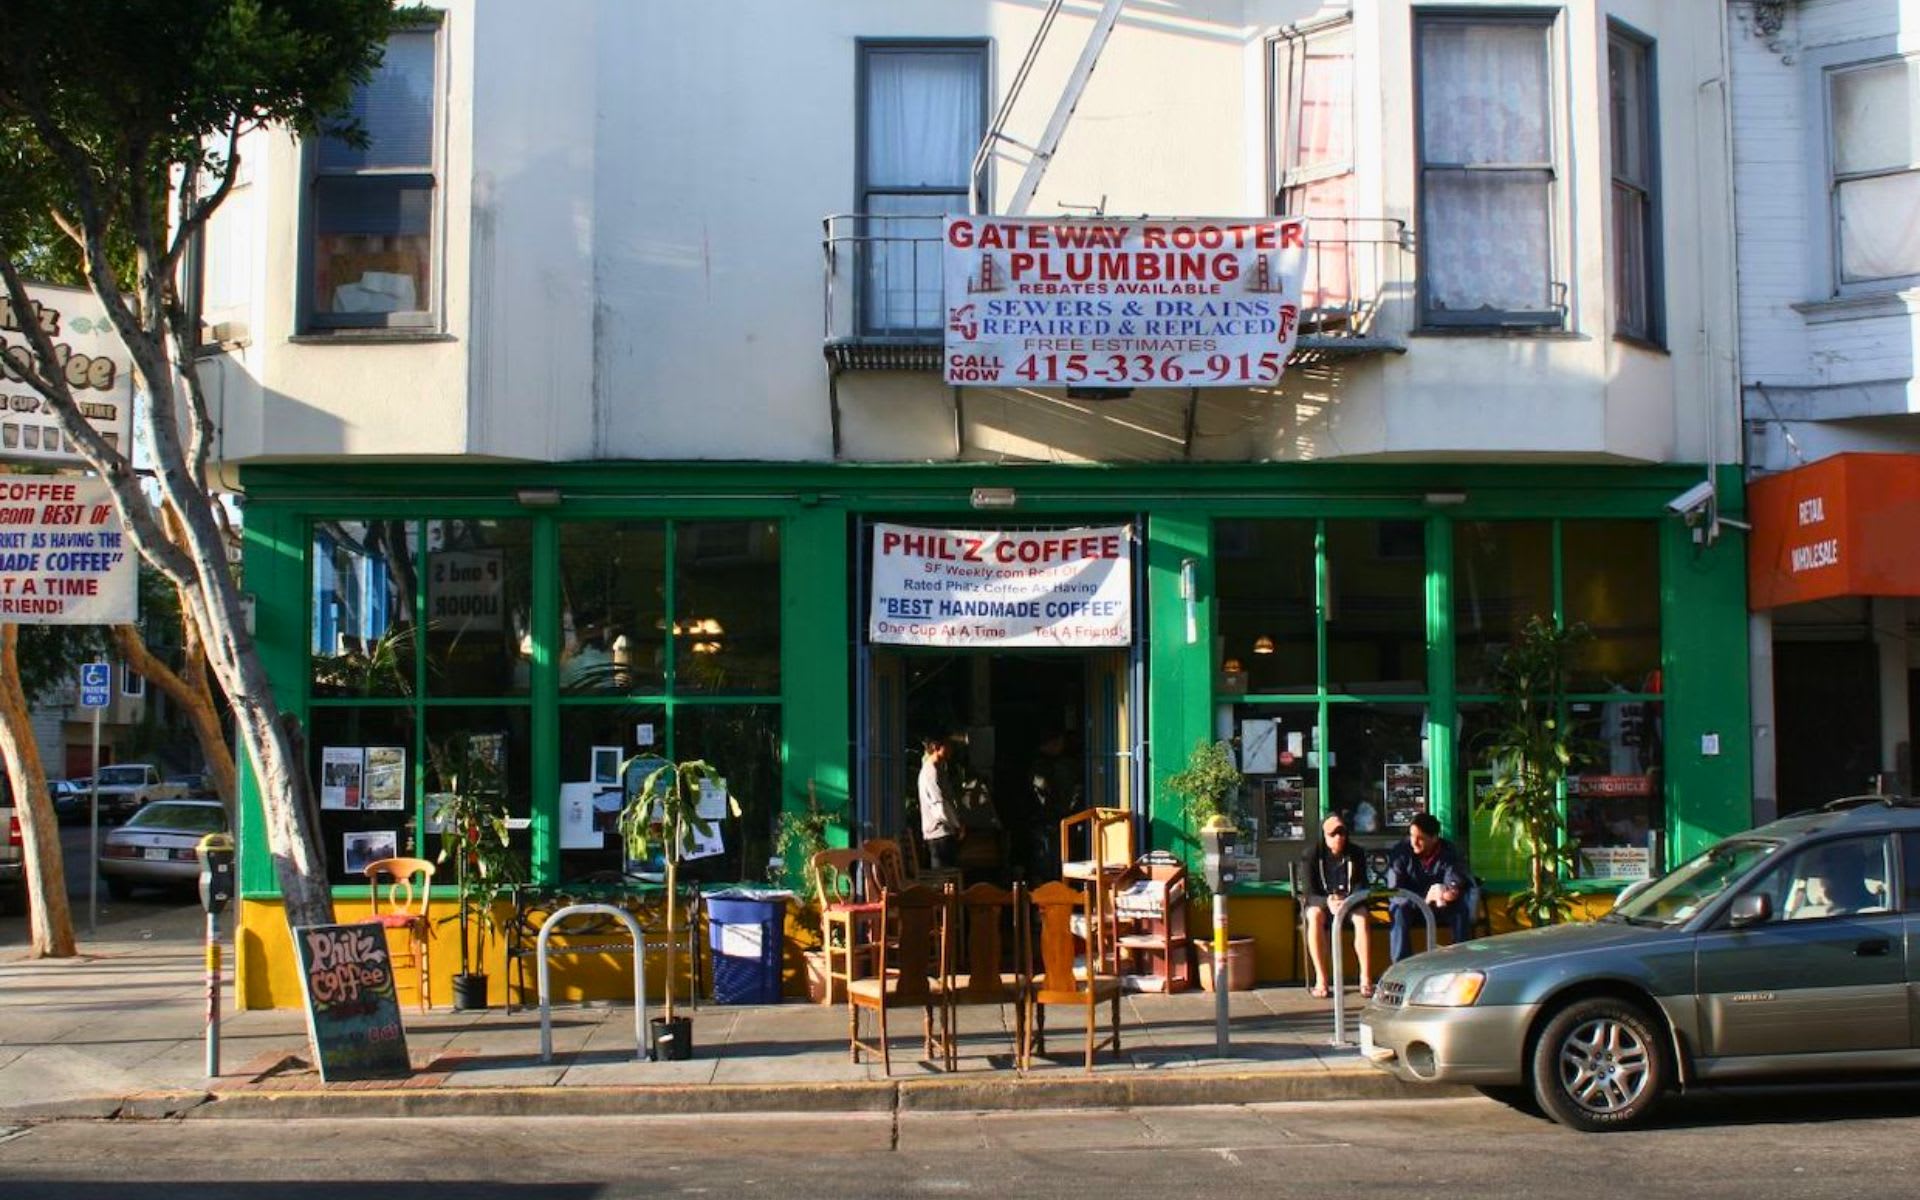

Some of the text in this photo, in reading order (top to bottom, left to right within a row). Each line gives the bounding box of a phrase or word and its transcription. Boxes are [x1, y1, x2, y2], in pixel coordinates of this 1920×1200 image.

[948, 220, 1305, 249] GATEWAY ROOTER
[1010, 252, 1240, 282] PLUMBING
[1019, 283, 1221, 295] REBATES AVAILABLE
[988, 300, 1270, 317] SEWERS & DRAINS
[983, 319, 1276, 336] REPAIRED & REPLACED
[1023, 338, 1218, 352] FREE ESTIMATES
[950, 354, 1005, 369] CALL
[1015, 353, 1288, 383] 415-336-915
[950, 368, 1000, 382] NOW
[41, 505, 86, 525] BEST
[90, 505, 112, 525] OF
[1799, 496, 1825, 527] RETAIL
[31, 532, 47, 549] AS
[50, 532, 95, 549] HAVING
[98, 532, 122, 549] THE
[883, 532, 1120, 563] PHIL'Z COFFEE
[1791, 538, 1838, 573] WHOLESALE
[924, 562, 942, 573] SF
[945, 564, 1024, 580] Weekly.com
[3, 578, 98, 596] T A TIME
[904, 579, 941, 592] Rated
[984, 583, 1027, 594] Coffee
[1032, 583, 1049, 593] As
[1053, 582, 1098, 596] Having
[1, 598, 63, 615] RIEND!
[879, 598, 1122, 618] "BEST HANDMADE COFFEE"
[878, 621, 905, 634] One
[909, 624, 937, 637] Cup
[941, 626, 956, 637] At
[959, 626, 970, 637] A
[974, 626, 1007, 638] Time
[1062, 627, 1072, 638] A
[307, 929, 388, 974] Phil'z
